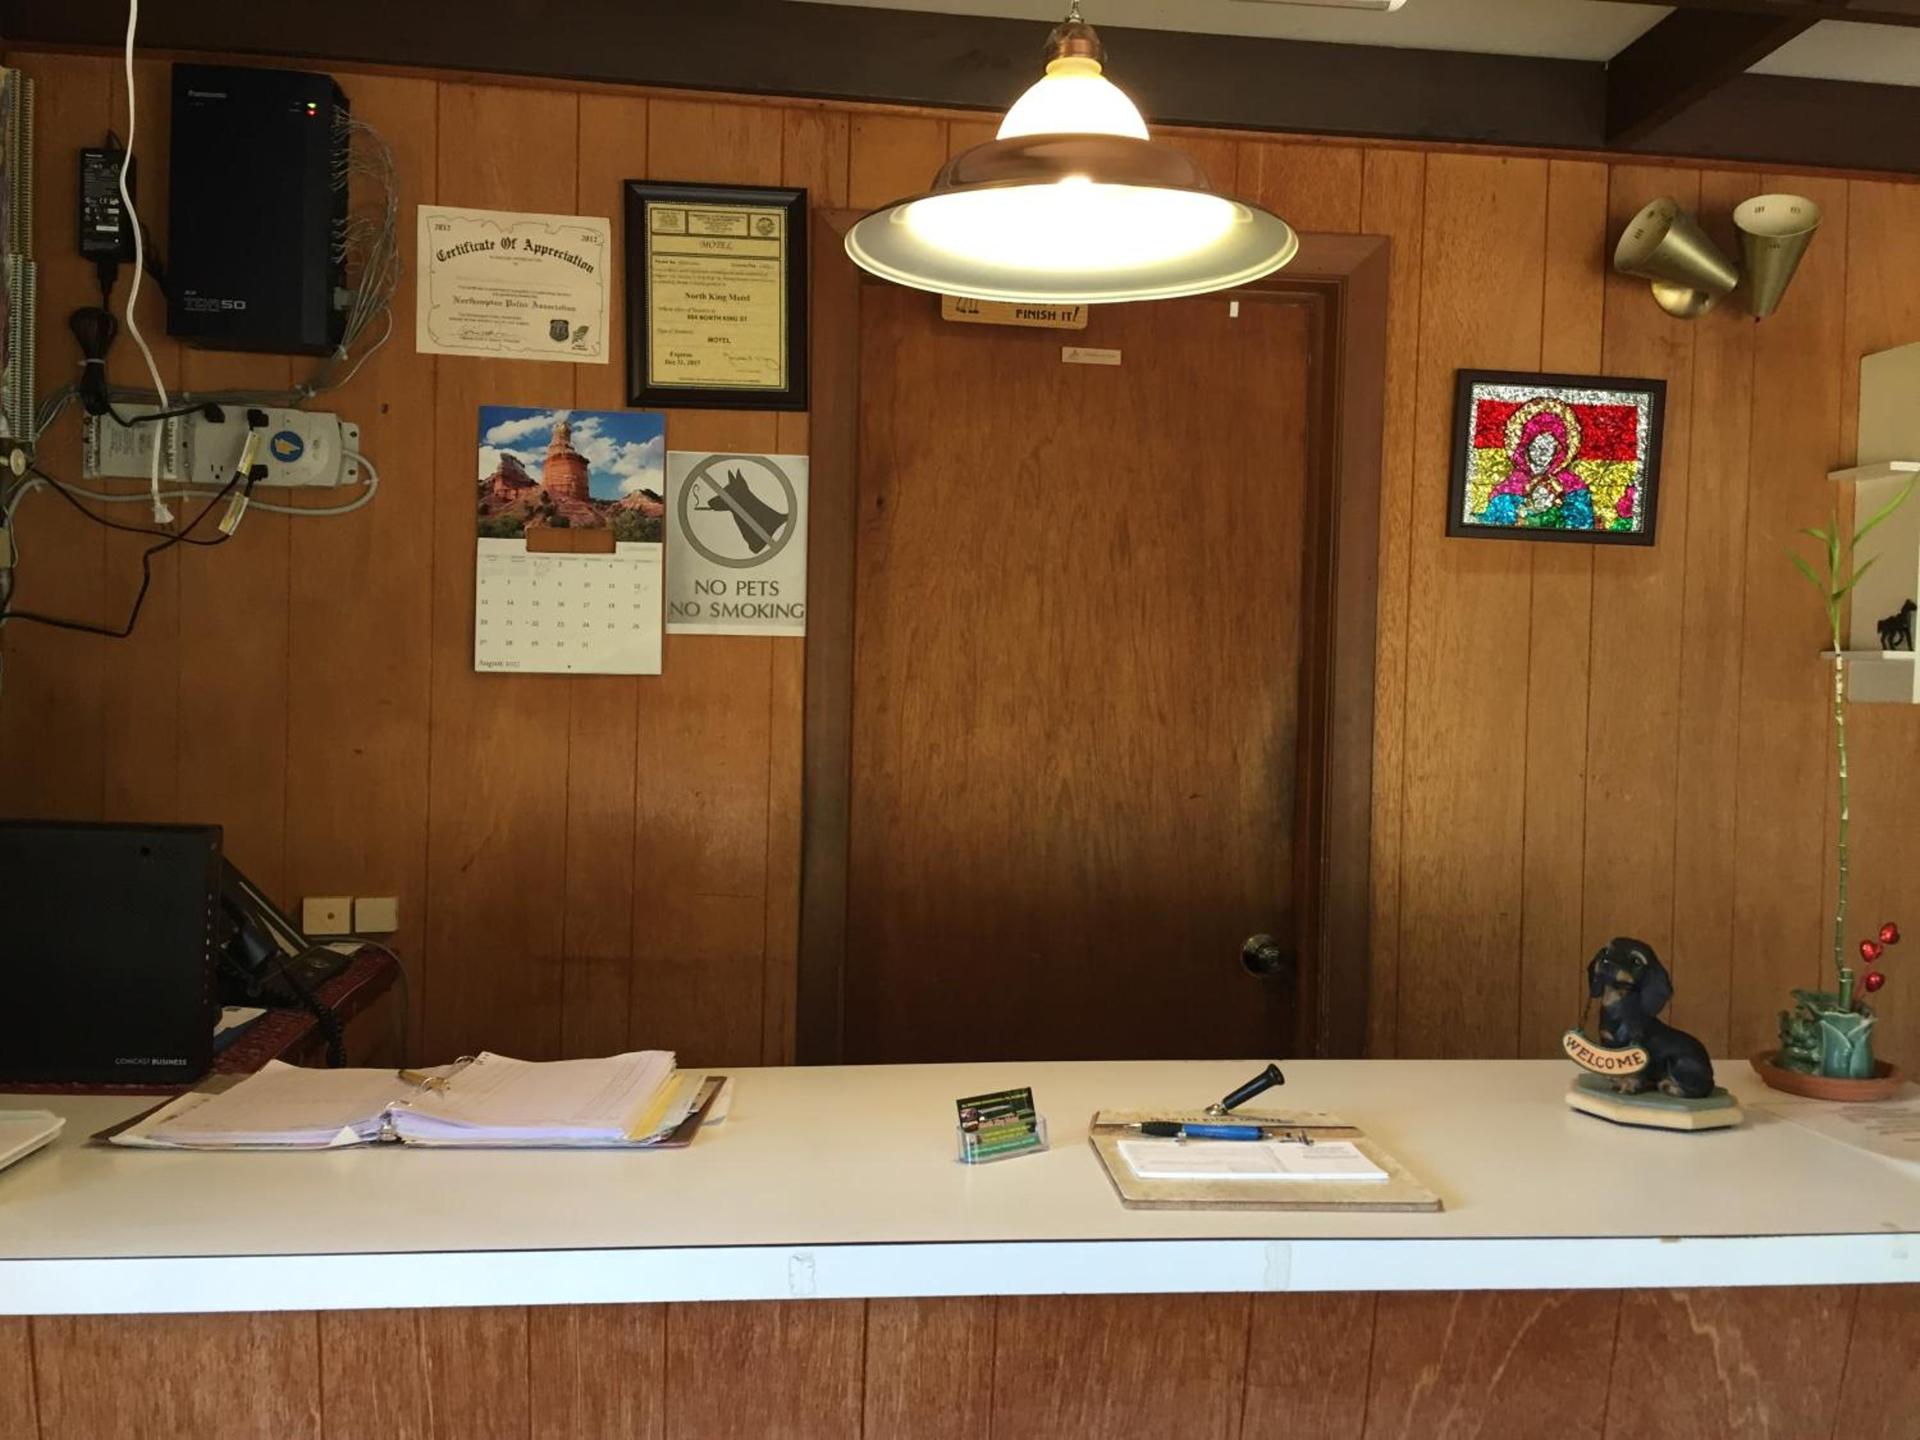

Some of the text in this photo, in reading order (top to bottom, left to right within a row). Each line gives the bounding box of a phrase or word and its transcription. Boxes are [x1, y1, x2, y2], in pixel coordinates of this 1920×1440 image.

[436, 236, 595, 275] Certificate Of Appreciation
[684, 292, 708, 301] North
[708, 293, 728, 304] King
[1015, 306, 1081, 322] FINISH IT!
[694, 579, 779, 596] NO PETS
[670, 601, 805, 619] NO SMOKING
[1566, 1036, 1644, 1069] WELCOME
[151, 1058, 187, 1066] BUSINESS
